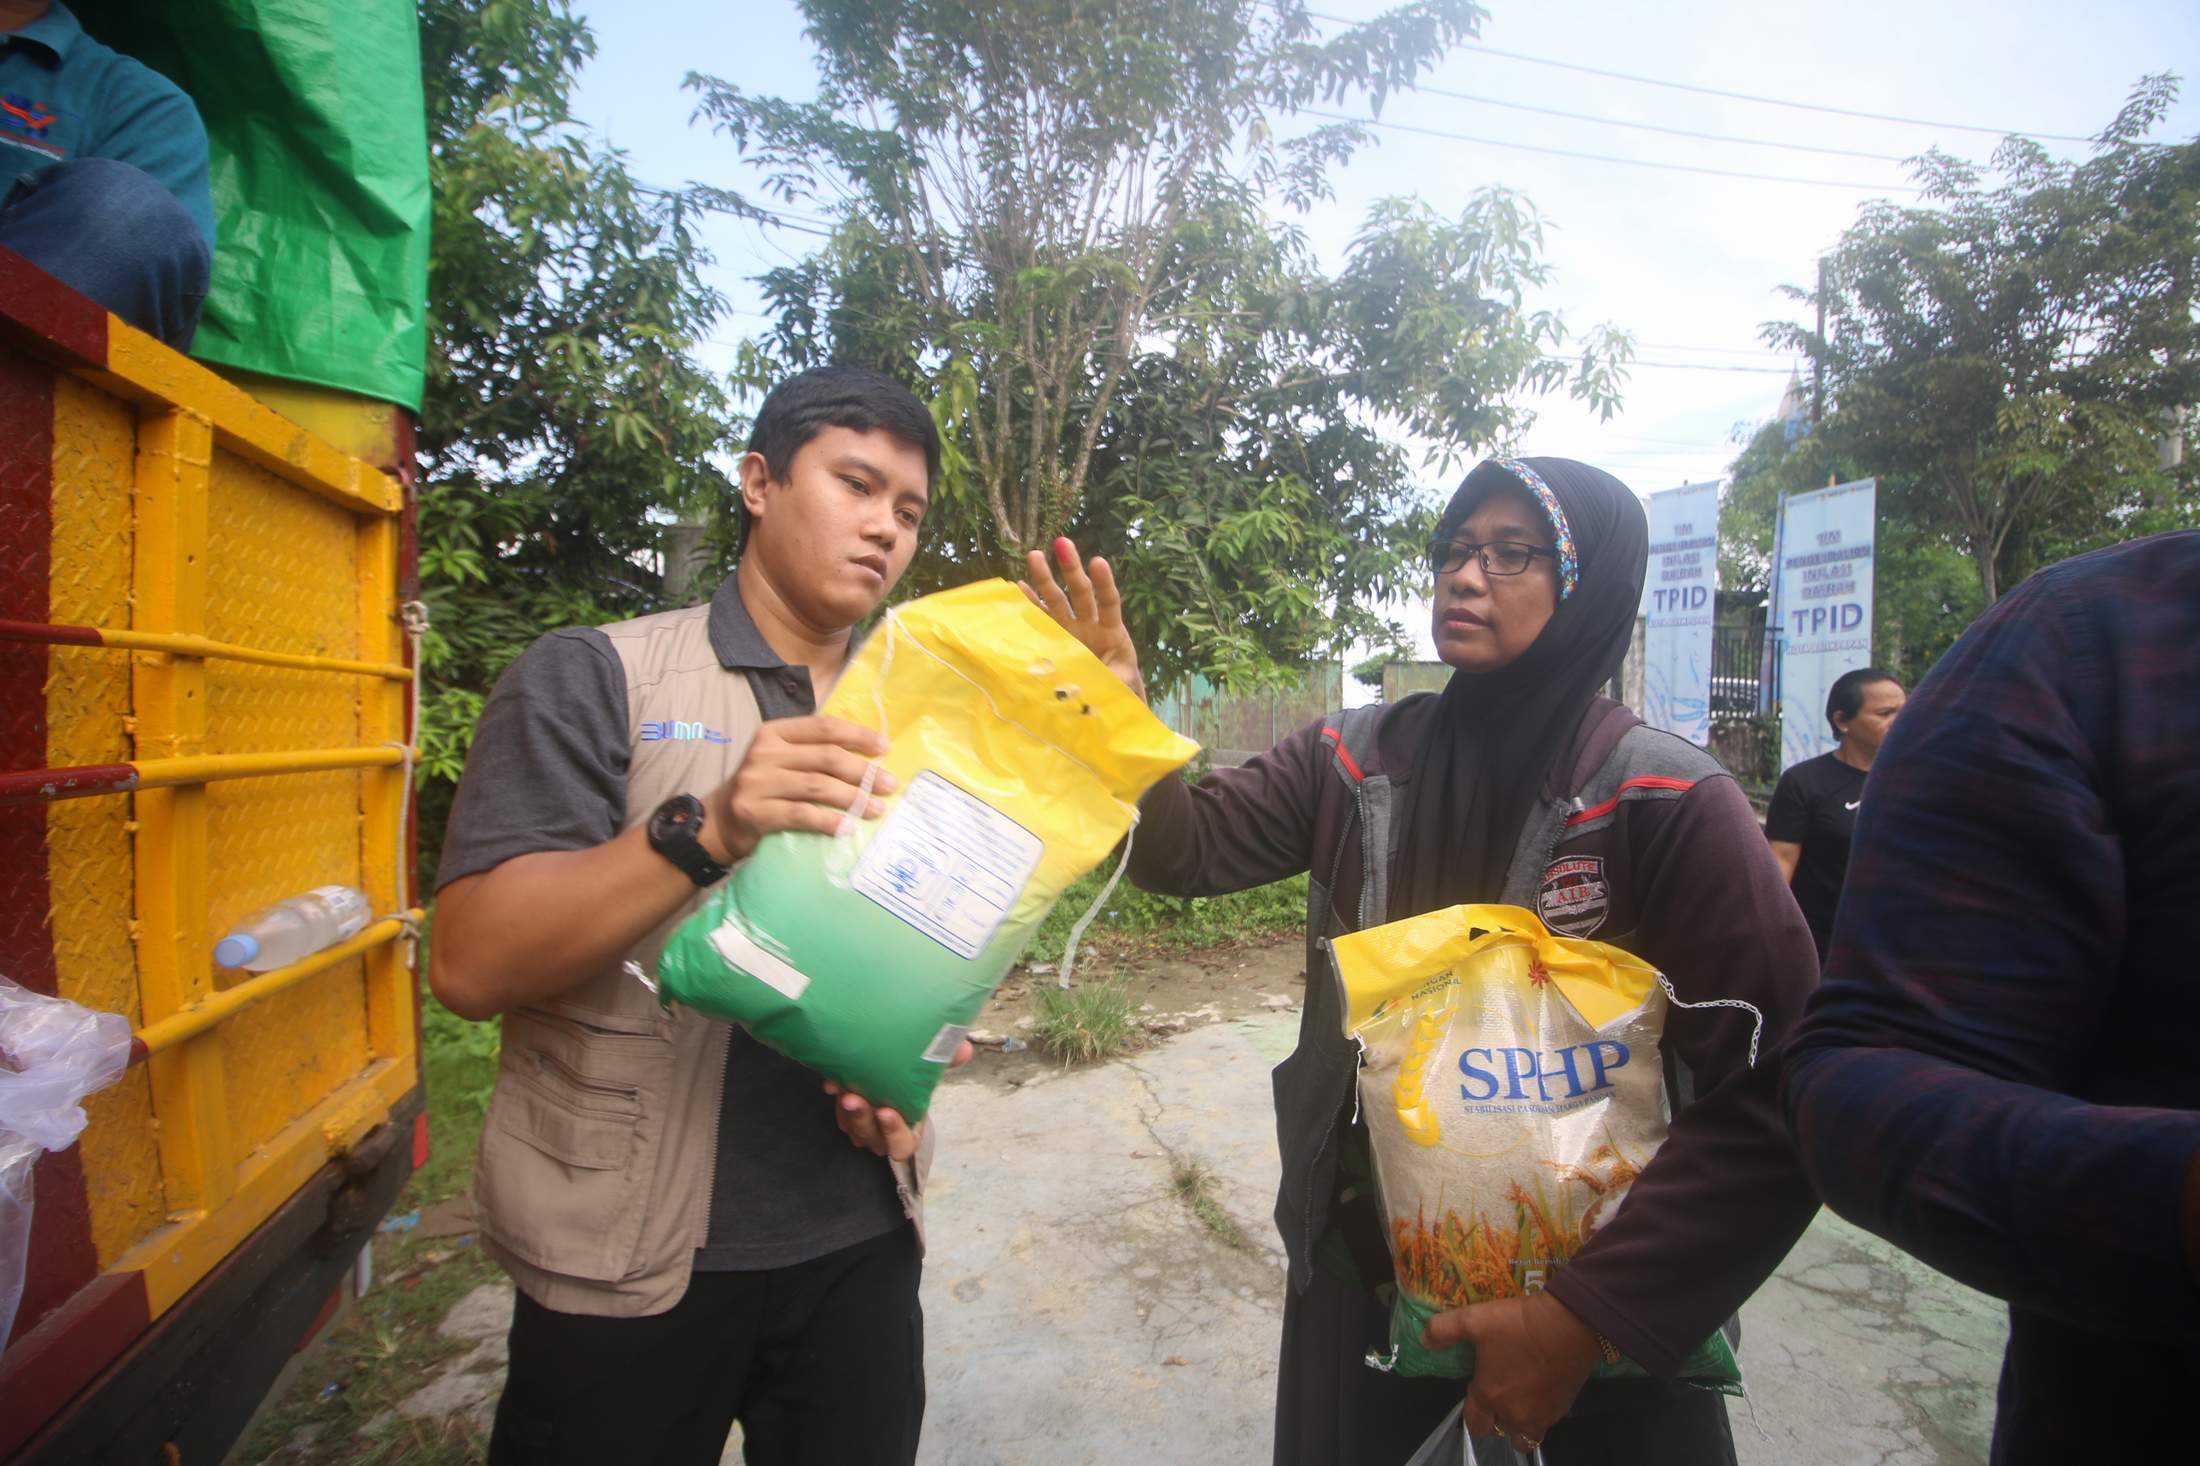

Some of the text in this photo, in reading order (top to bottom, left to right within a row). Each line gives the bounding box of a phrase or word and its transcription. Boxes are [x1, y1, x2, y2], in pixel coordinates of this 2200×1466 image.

[1653, 585, 1707, 613] TPID
[1791, 603, 1863, 637] TPID
[1458, 1040, 1630, 1102] SPHP
